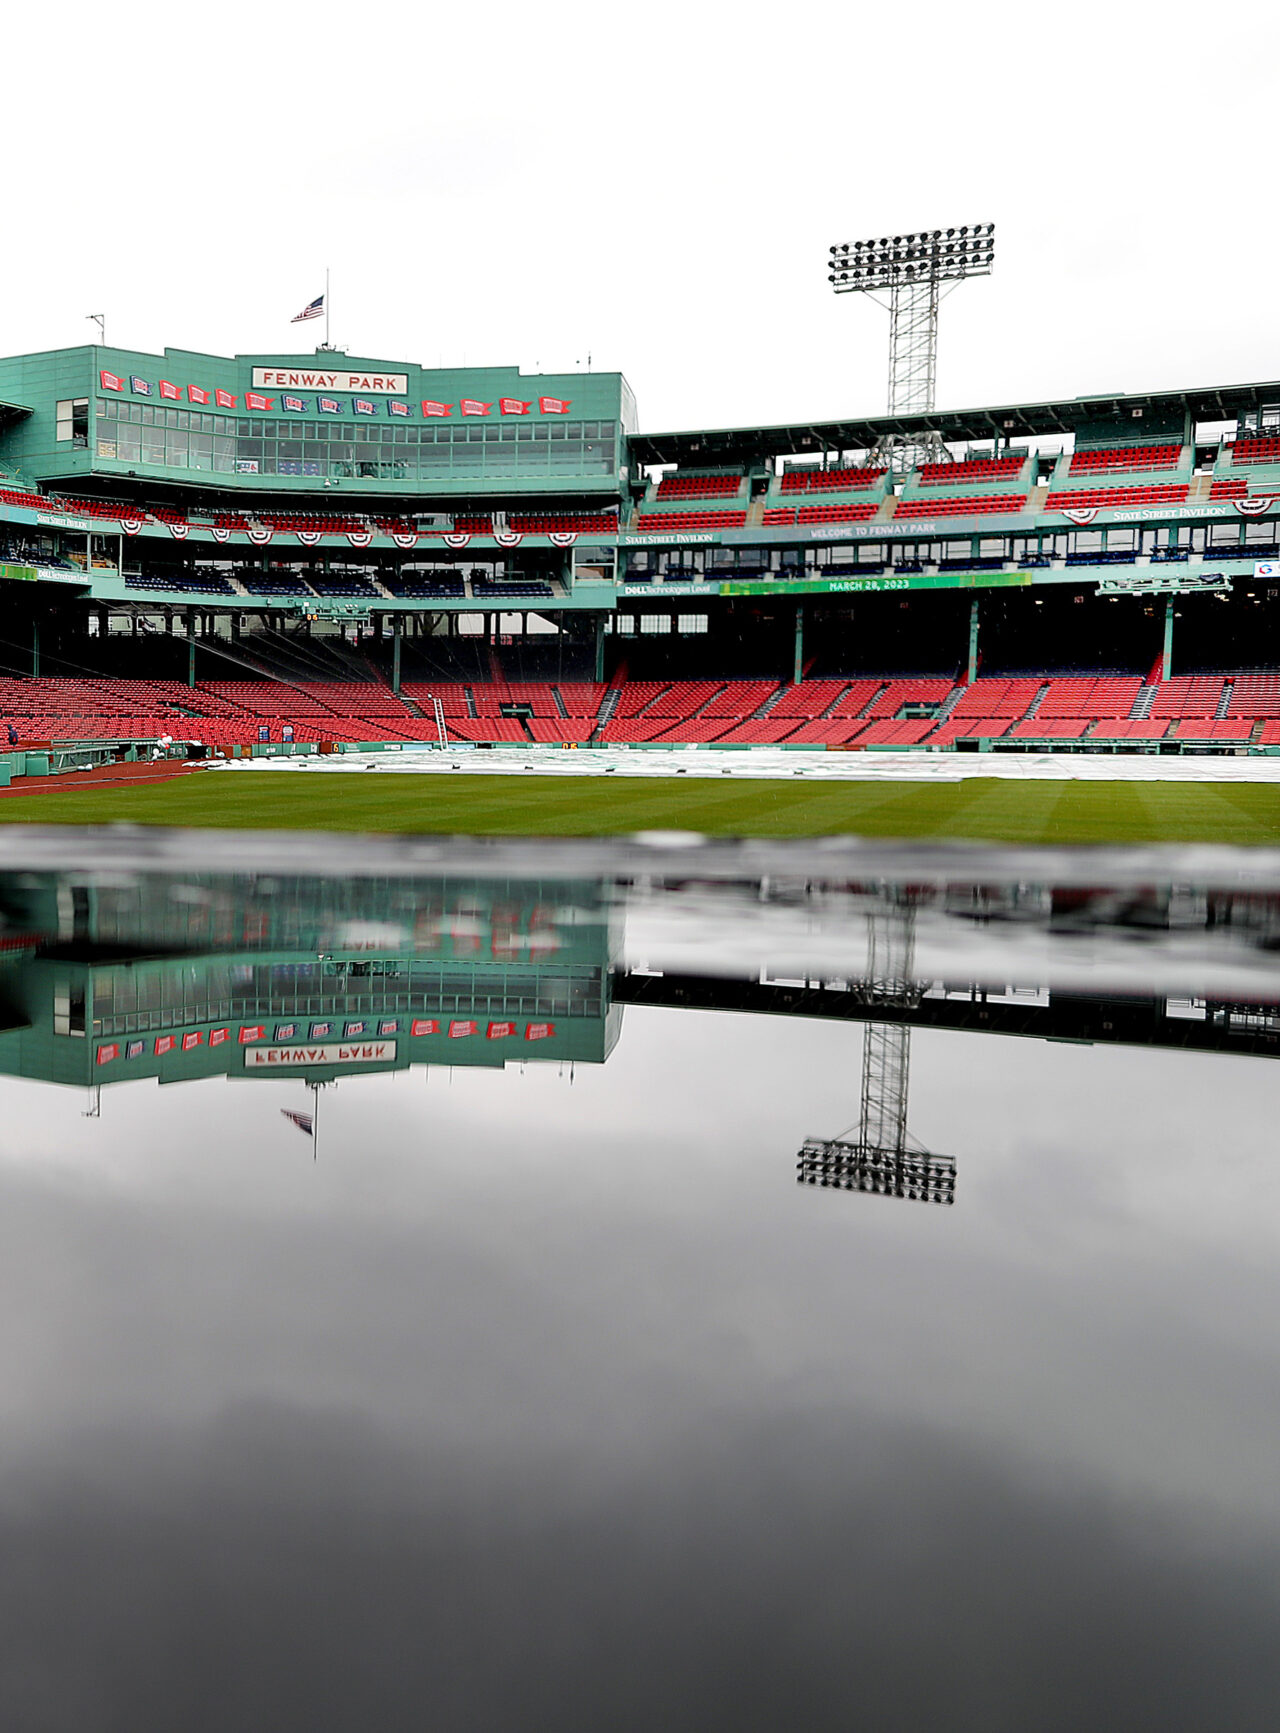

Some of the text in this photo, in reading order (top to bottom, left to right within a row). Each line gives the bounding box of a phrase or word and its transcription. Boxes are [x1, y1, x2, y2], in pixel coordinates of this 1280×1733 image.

[264, 372, 396, 390] FENWAY PARK
[1114, 507, 1226, 521] STATE STREET PAVILION
[811, 523, 936, 538] WELCOME TO FENWAY PARK
[625, 533, 713, 545] STATE STREET PAVILION
[625, 585, 711, 595] DELL Technologies Level
[829, 580, 910, 592] MARCH 28, 2023
